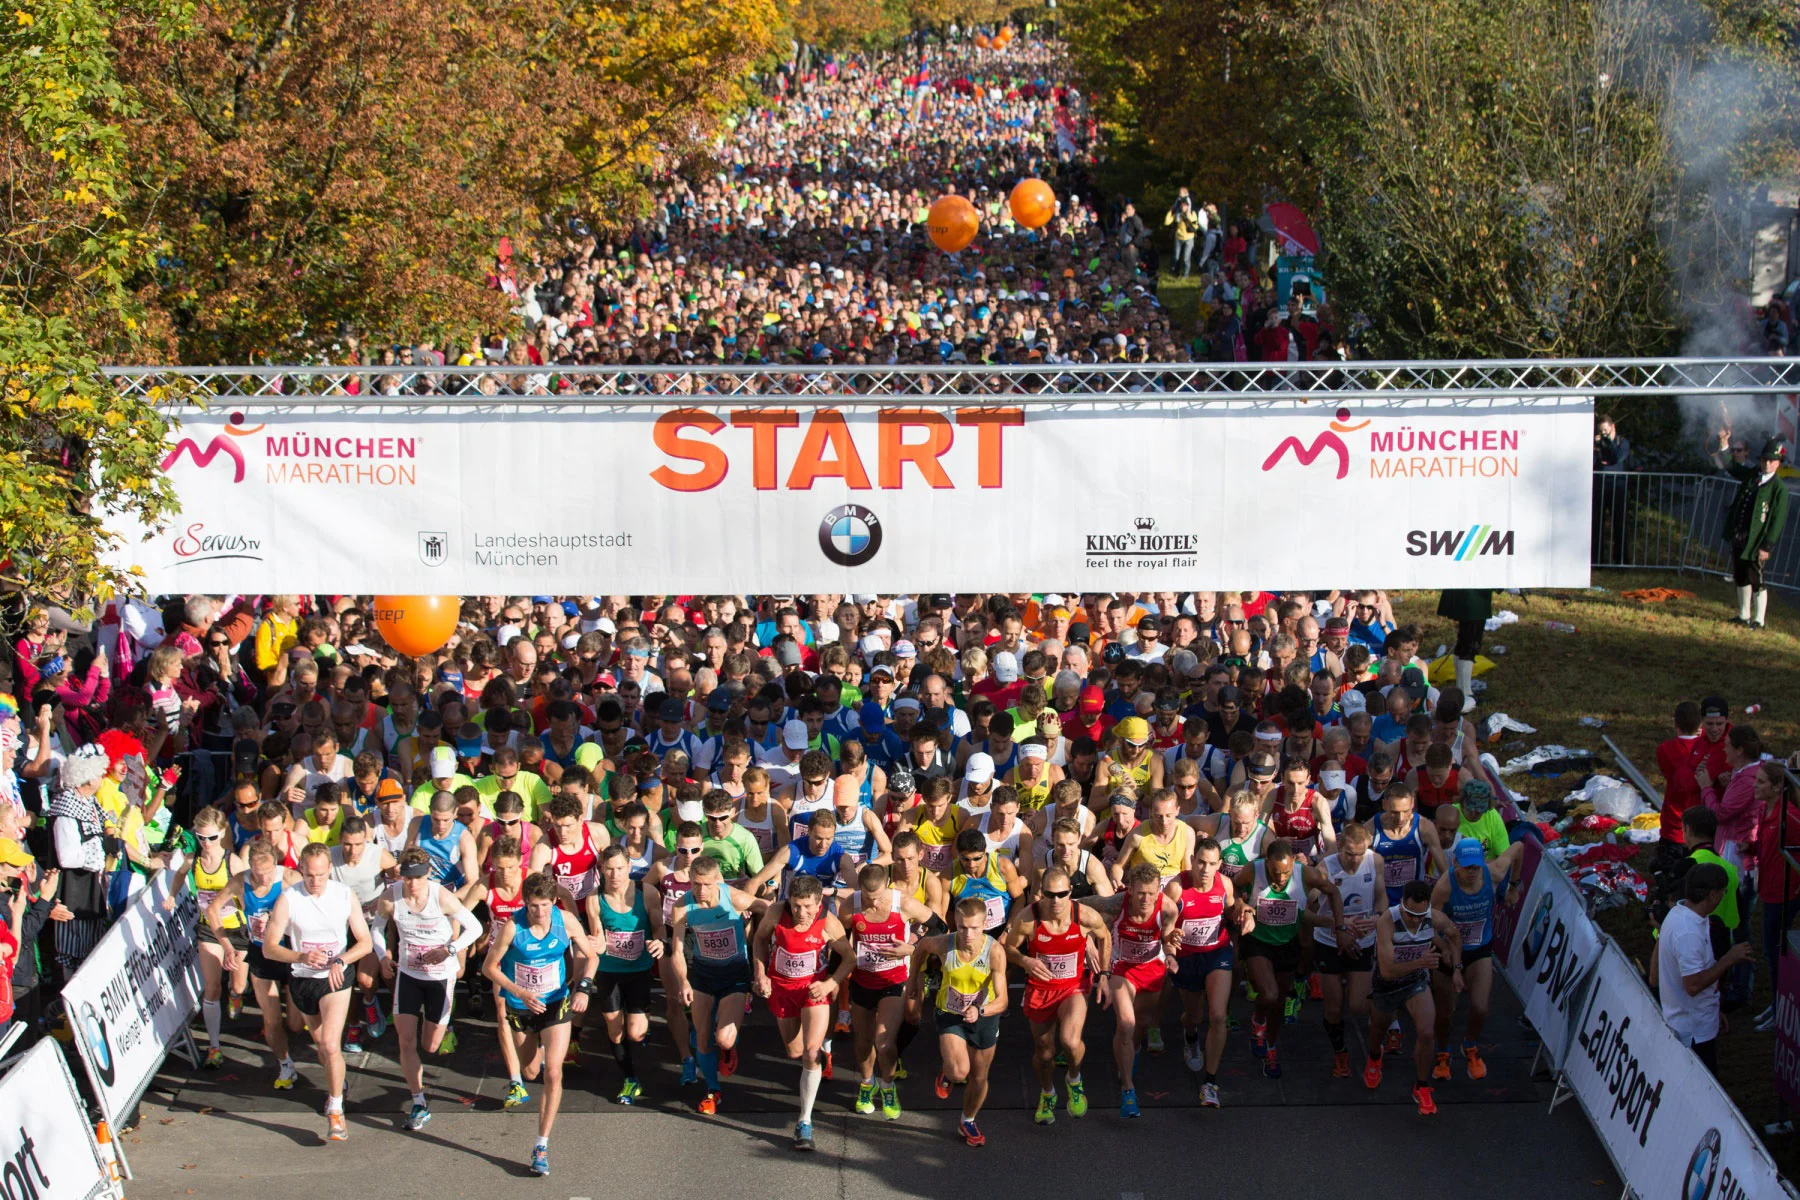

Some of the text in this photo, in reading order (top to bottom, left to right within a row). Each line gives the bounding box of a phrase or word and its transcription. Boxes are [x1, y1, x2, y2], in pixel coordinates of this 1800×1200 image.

[266, 431, 416, 459] MÜNCHEN
[1370, 425, 1519, 453] MÜNCHEN
[648, 407, 1026, 492] START
[265, 462, 416, 485] MARATHON
[1369, 456, 1519, 479] MARATHON
[824, 505, 878, 527] BMW
[474, 531, 633, 551] Landeshauptstadt
[1139, 534, 1198, 551] HOTELS
[474, 551, 559, 567] München
[1086, 557, 1198, 570] feel the royal flair
[927, 851, 944, 861] 190
[1267, 906, 1287, 916] 302
[859, 932, 897, 943] RUSSI
[1191, 926, 1211, 936] 247
[615, 940, 634, 950] 249
[703, 937, 730, 949] 5830
[1396, 951, 1423, 960] 2015
[785, 960, 805, 968] 464
[1047, 962, 1066, 970] 176
[525, 973, 544, 984] 151
[100, 968, 131, 1026] BMW
[1577, 975, 1665, 1150] Laufsport
[0, 1126, 51, 1200] ort
